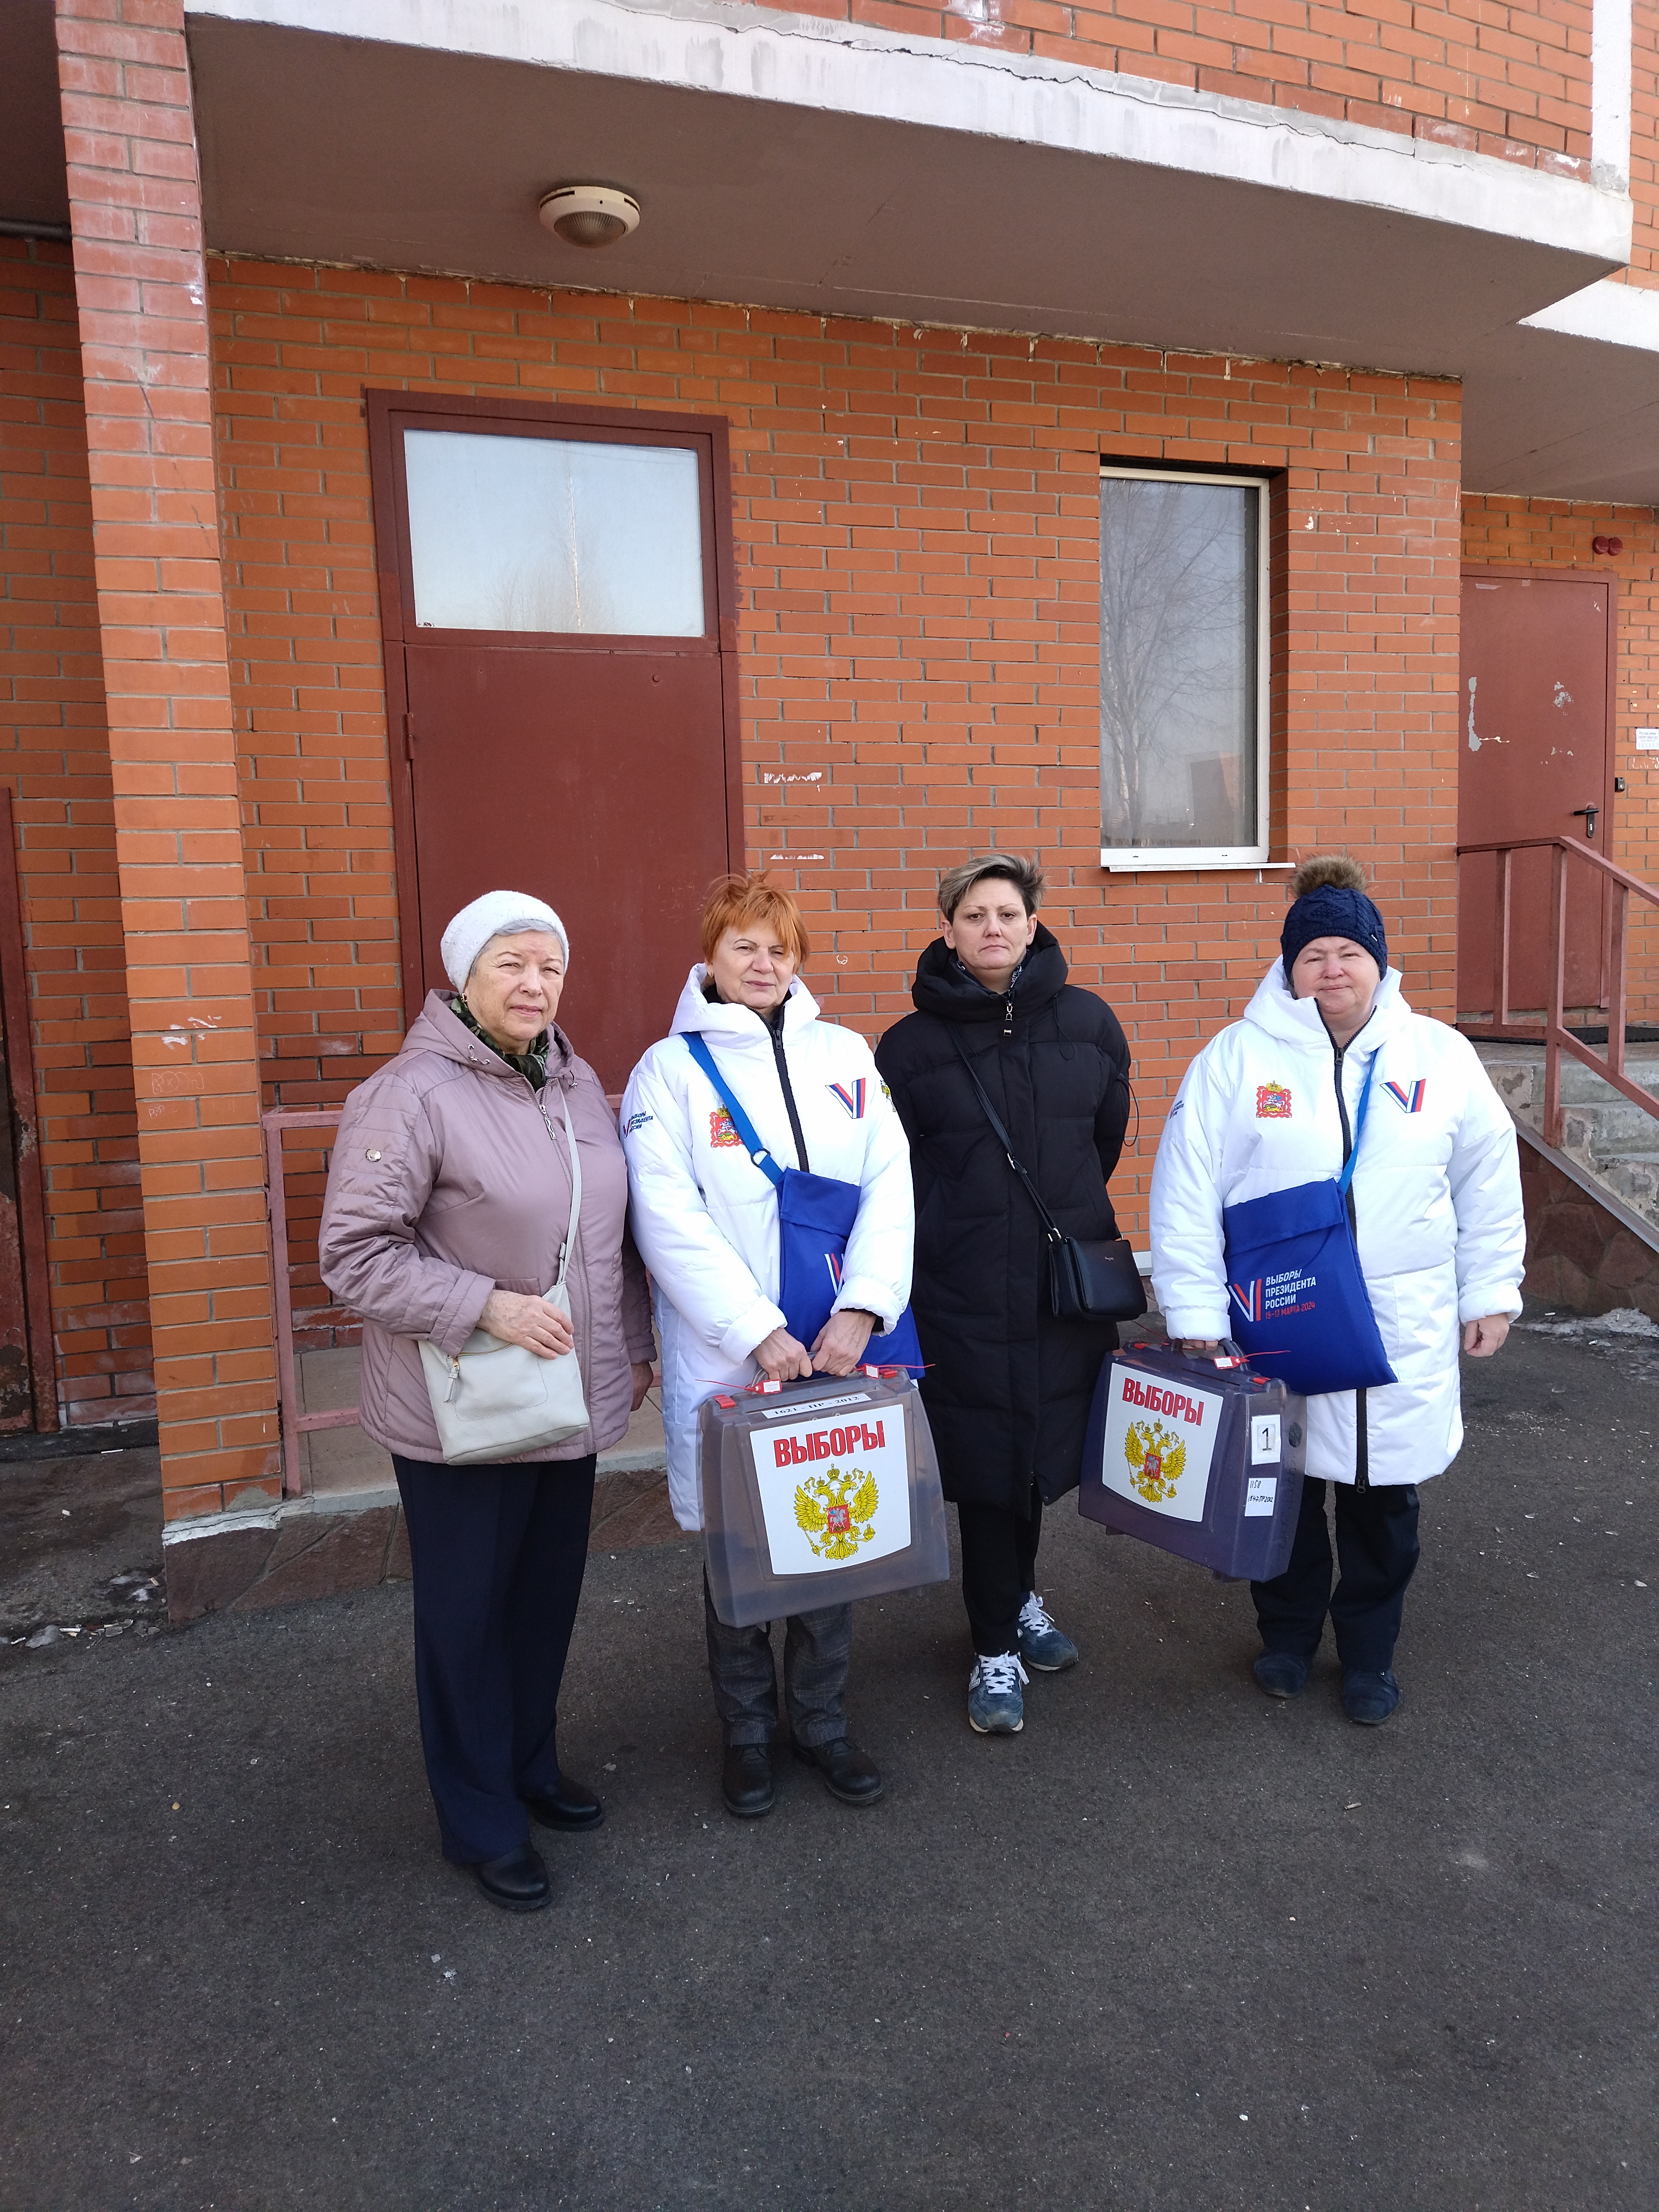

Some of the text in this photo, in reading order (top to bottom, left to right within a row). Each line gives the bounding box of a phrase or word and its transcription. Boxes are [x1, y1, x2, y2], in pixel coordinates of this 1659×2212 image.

[1265, 1269, 1302, 1286] ВЫБОРЫ
[1265, 1276, 1317, 1298] ПРЕЗИДЕНТА
[1265, 1294, 1296, 1310] РОССИИ
[1281, 1305, 1300, 1316] МАРТА
[1122, 1377, 1204, 1426] ВЫБОРЫ
[773, 1420, 886, 1468] ВЫБОРЫ
[1262, 1427, 1272, 1451] 1
[1250, 1479, 1262, 1489] 1158
